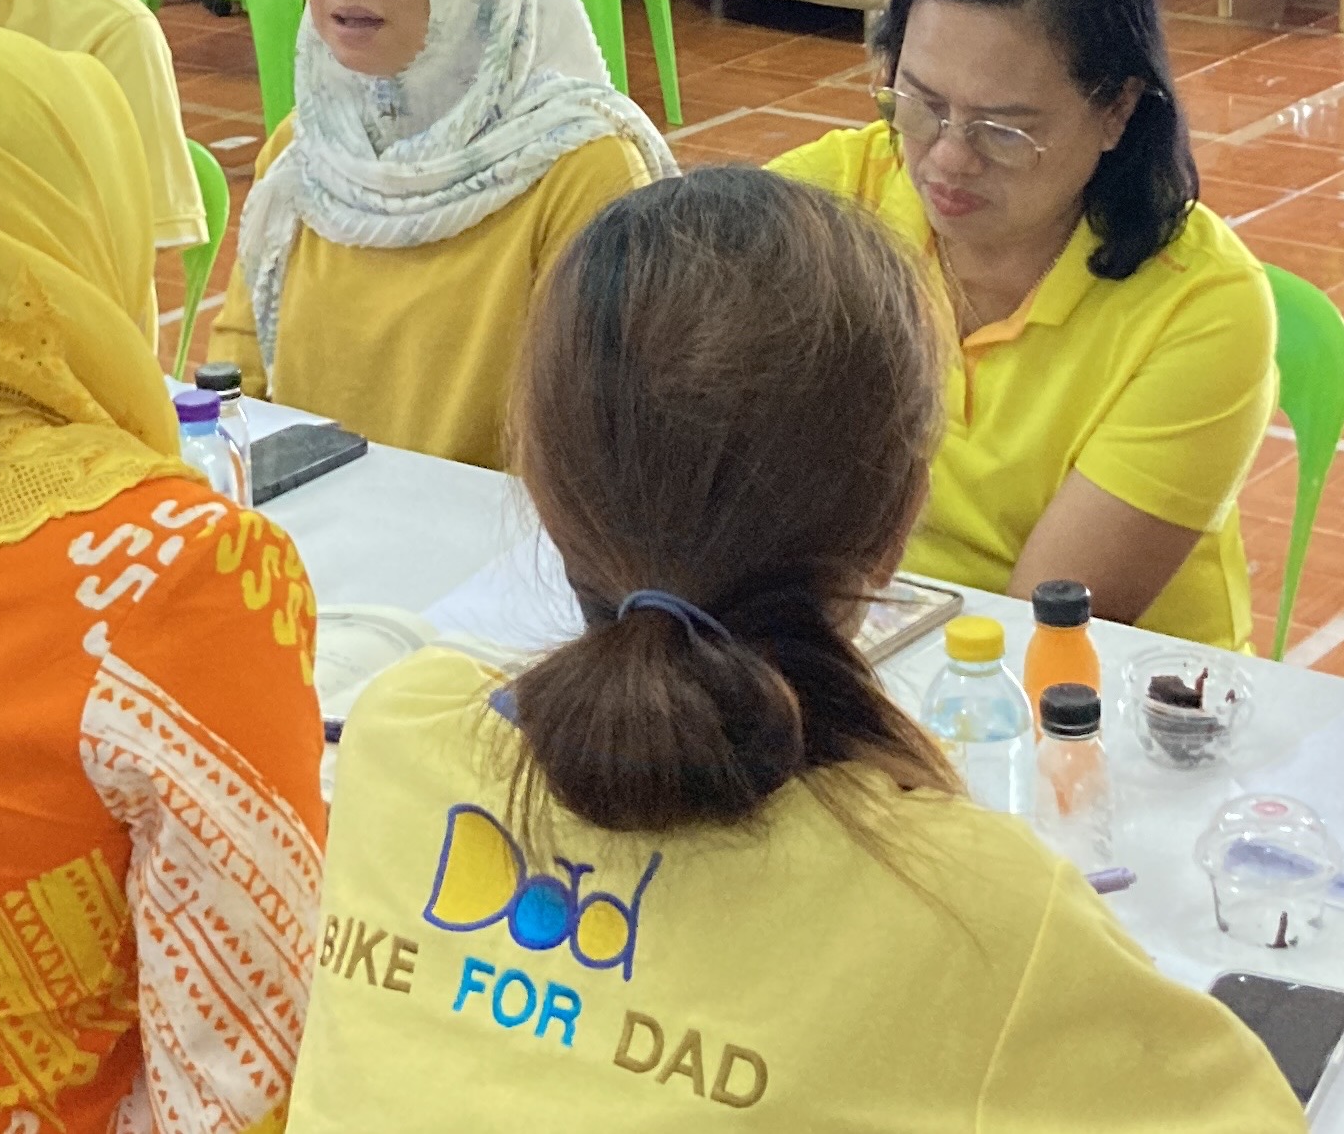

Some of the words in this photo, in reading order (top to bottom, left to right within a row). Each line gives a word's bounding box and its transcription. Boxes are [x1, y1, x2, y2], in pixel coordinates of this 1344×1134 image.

[319, 914, 420, 994] BIKE
[451, 956, 582, 1048] FOR
[612, 1010, 769, 1109] DAD
